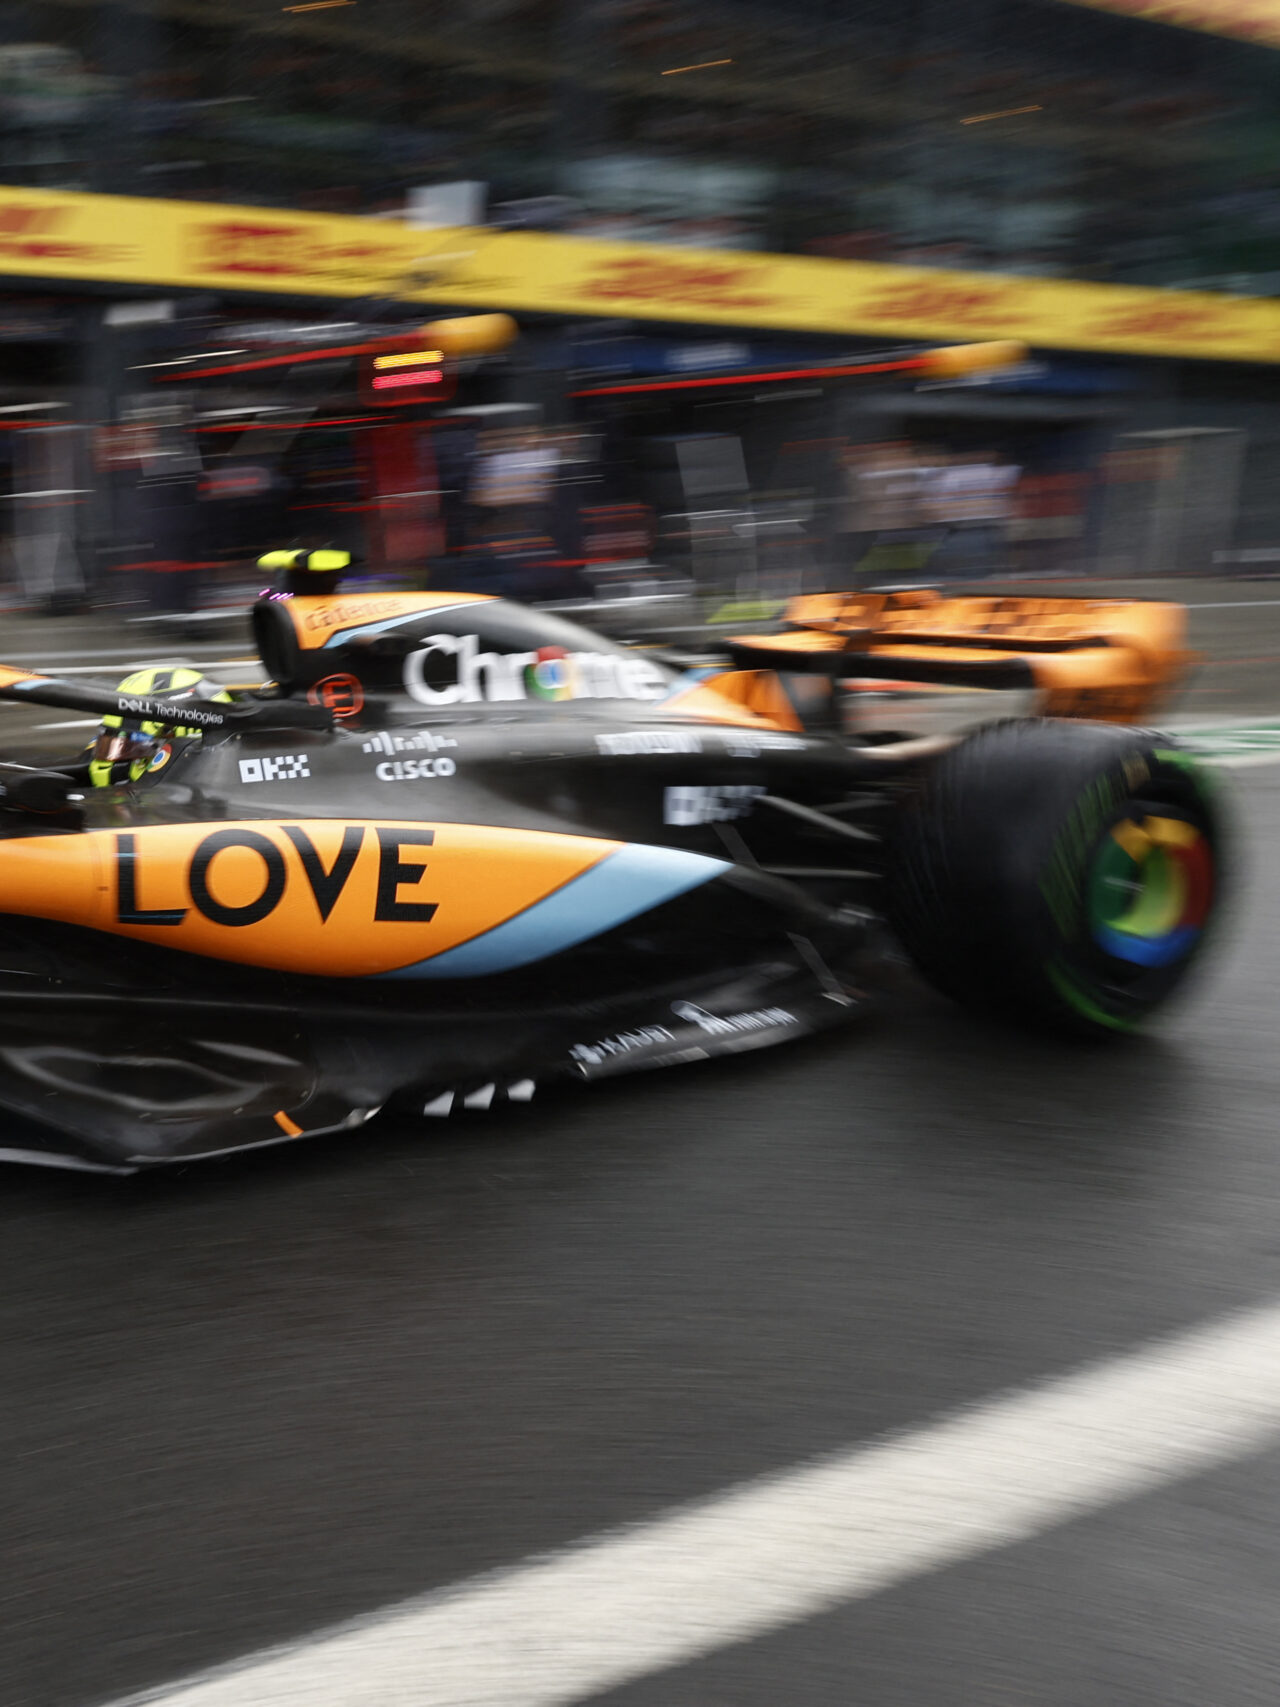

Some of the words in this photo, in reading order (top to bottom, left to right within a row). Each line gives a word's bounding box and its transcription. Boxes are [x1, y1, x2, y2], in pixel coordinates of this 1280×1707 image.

[118, 698, 153, 714] DELL
[155, 702, 224, 724] Technologies
[239, 754, 310, 783] OKX
[116, 826, 439, 927] LOVE
